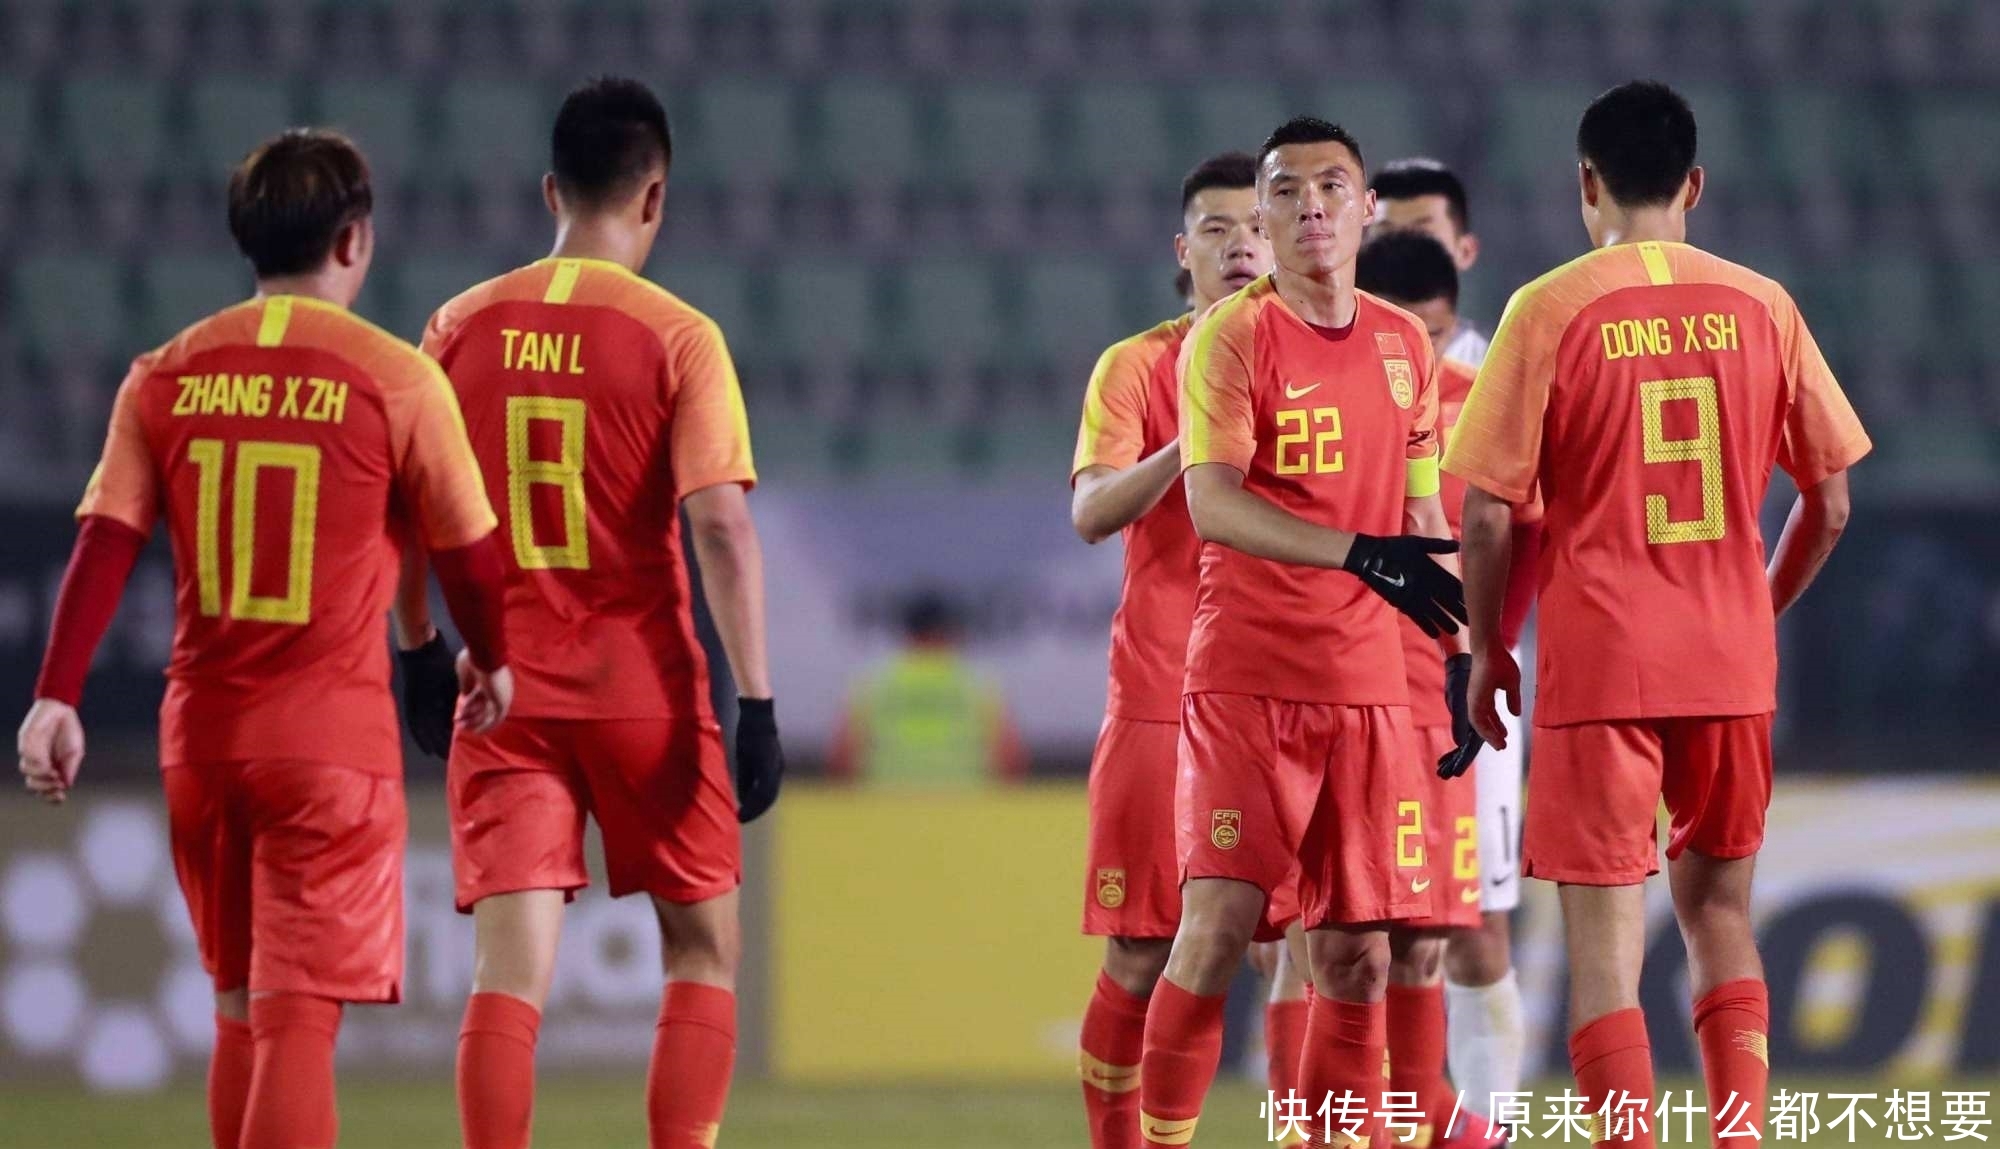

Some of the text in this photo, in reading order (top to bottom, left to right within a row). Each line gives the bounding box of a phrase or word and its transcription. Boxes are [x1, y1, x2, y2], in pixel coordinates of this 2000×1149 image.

[501, 328, 585, 375] TAN L
[1600, 317, 1673, 360] DONG
[171, 372, 274, 417] ZHANG
[1275, 406, 1345, 475] 22
[1639, 376, 1727, 545] 9
[506, 395, 591, 570] 8
[188, 438, 321, 625] 10
[1396, 800, 1424, 867] 2
[1453, 815, 1478, 880] 2
